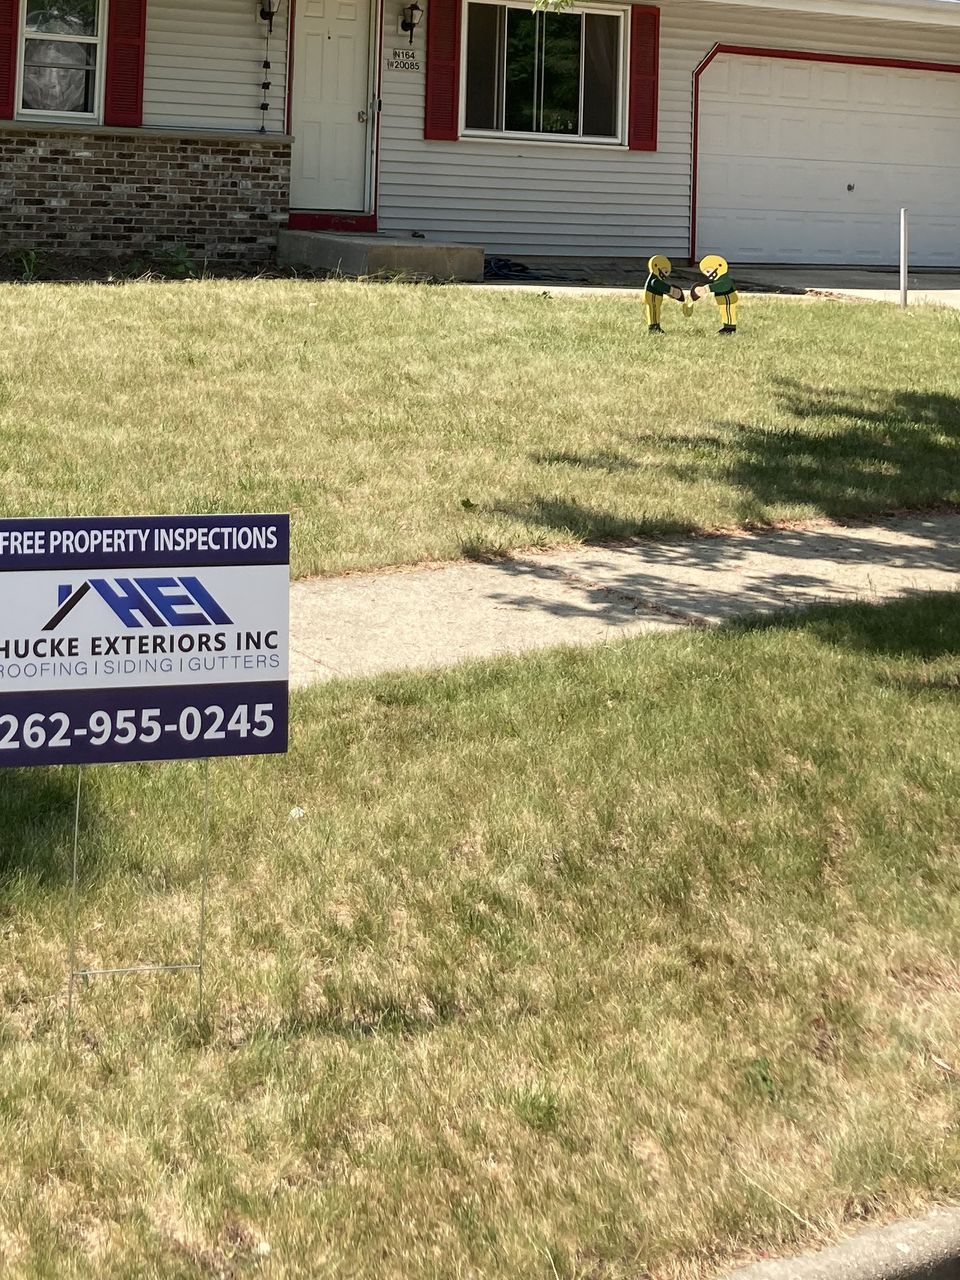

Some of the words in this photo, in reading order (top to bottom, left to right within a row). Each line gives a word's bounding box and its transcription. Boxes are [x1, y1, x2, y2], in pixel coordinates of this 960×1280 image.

[394, 50, 415, 60] N164
[49, 529, 150, 554] PROPERTY
[154, 526, 278, 552] INSPECTIONS
[87, 576, 235, 628] HEI
[91, 632, 227, 656] EXTERIORS
[236, 630, 278, 651] INC
[103, 658, 173, 675] SIDING
[188, 654, 280, 672] GUTTERS
